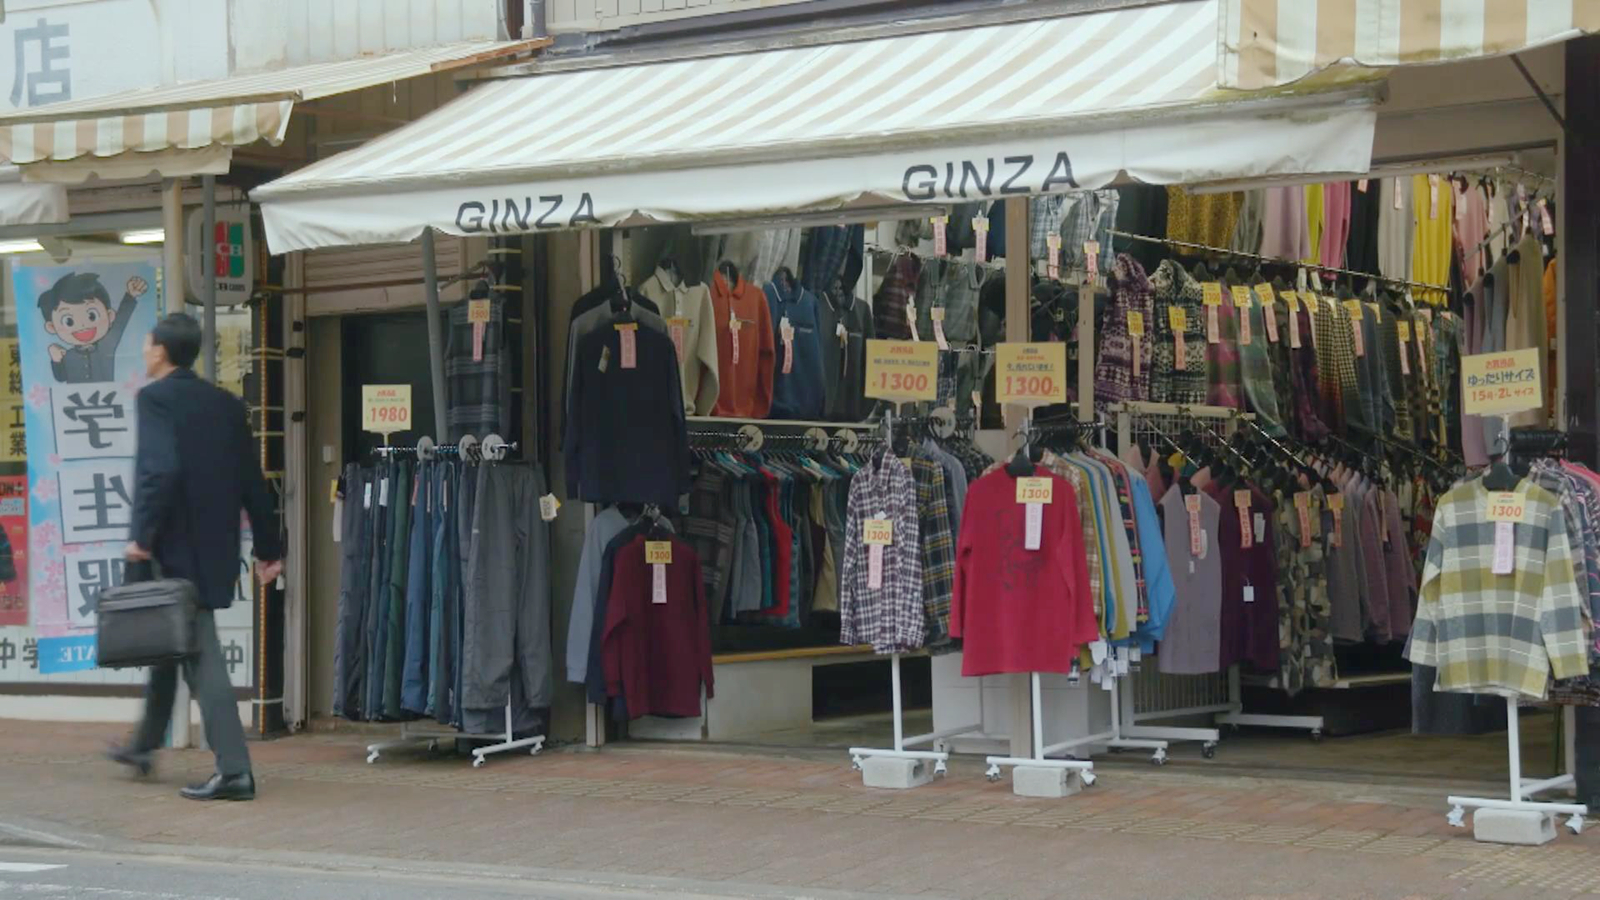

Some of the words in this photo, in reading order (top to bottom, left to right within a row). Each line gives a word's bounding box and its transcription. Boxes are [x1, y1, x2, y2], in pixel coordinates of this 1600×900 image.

[9, 17, 72, 107] 店
[902, 151, 1080, 201] GINZA
[455, 192, 603, 234] GINZA
[371, 406, 408, 423] 1980
[1022, 489, 1050, 499] 1300
[1492, 505, 1522, 517] 1300
[866, 530, 890, 541] 1300
